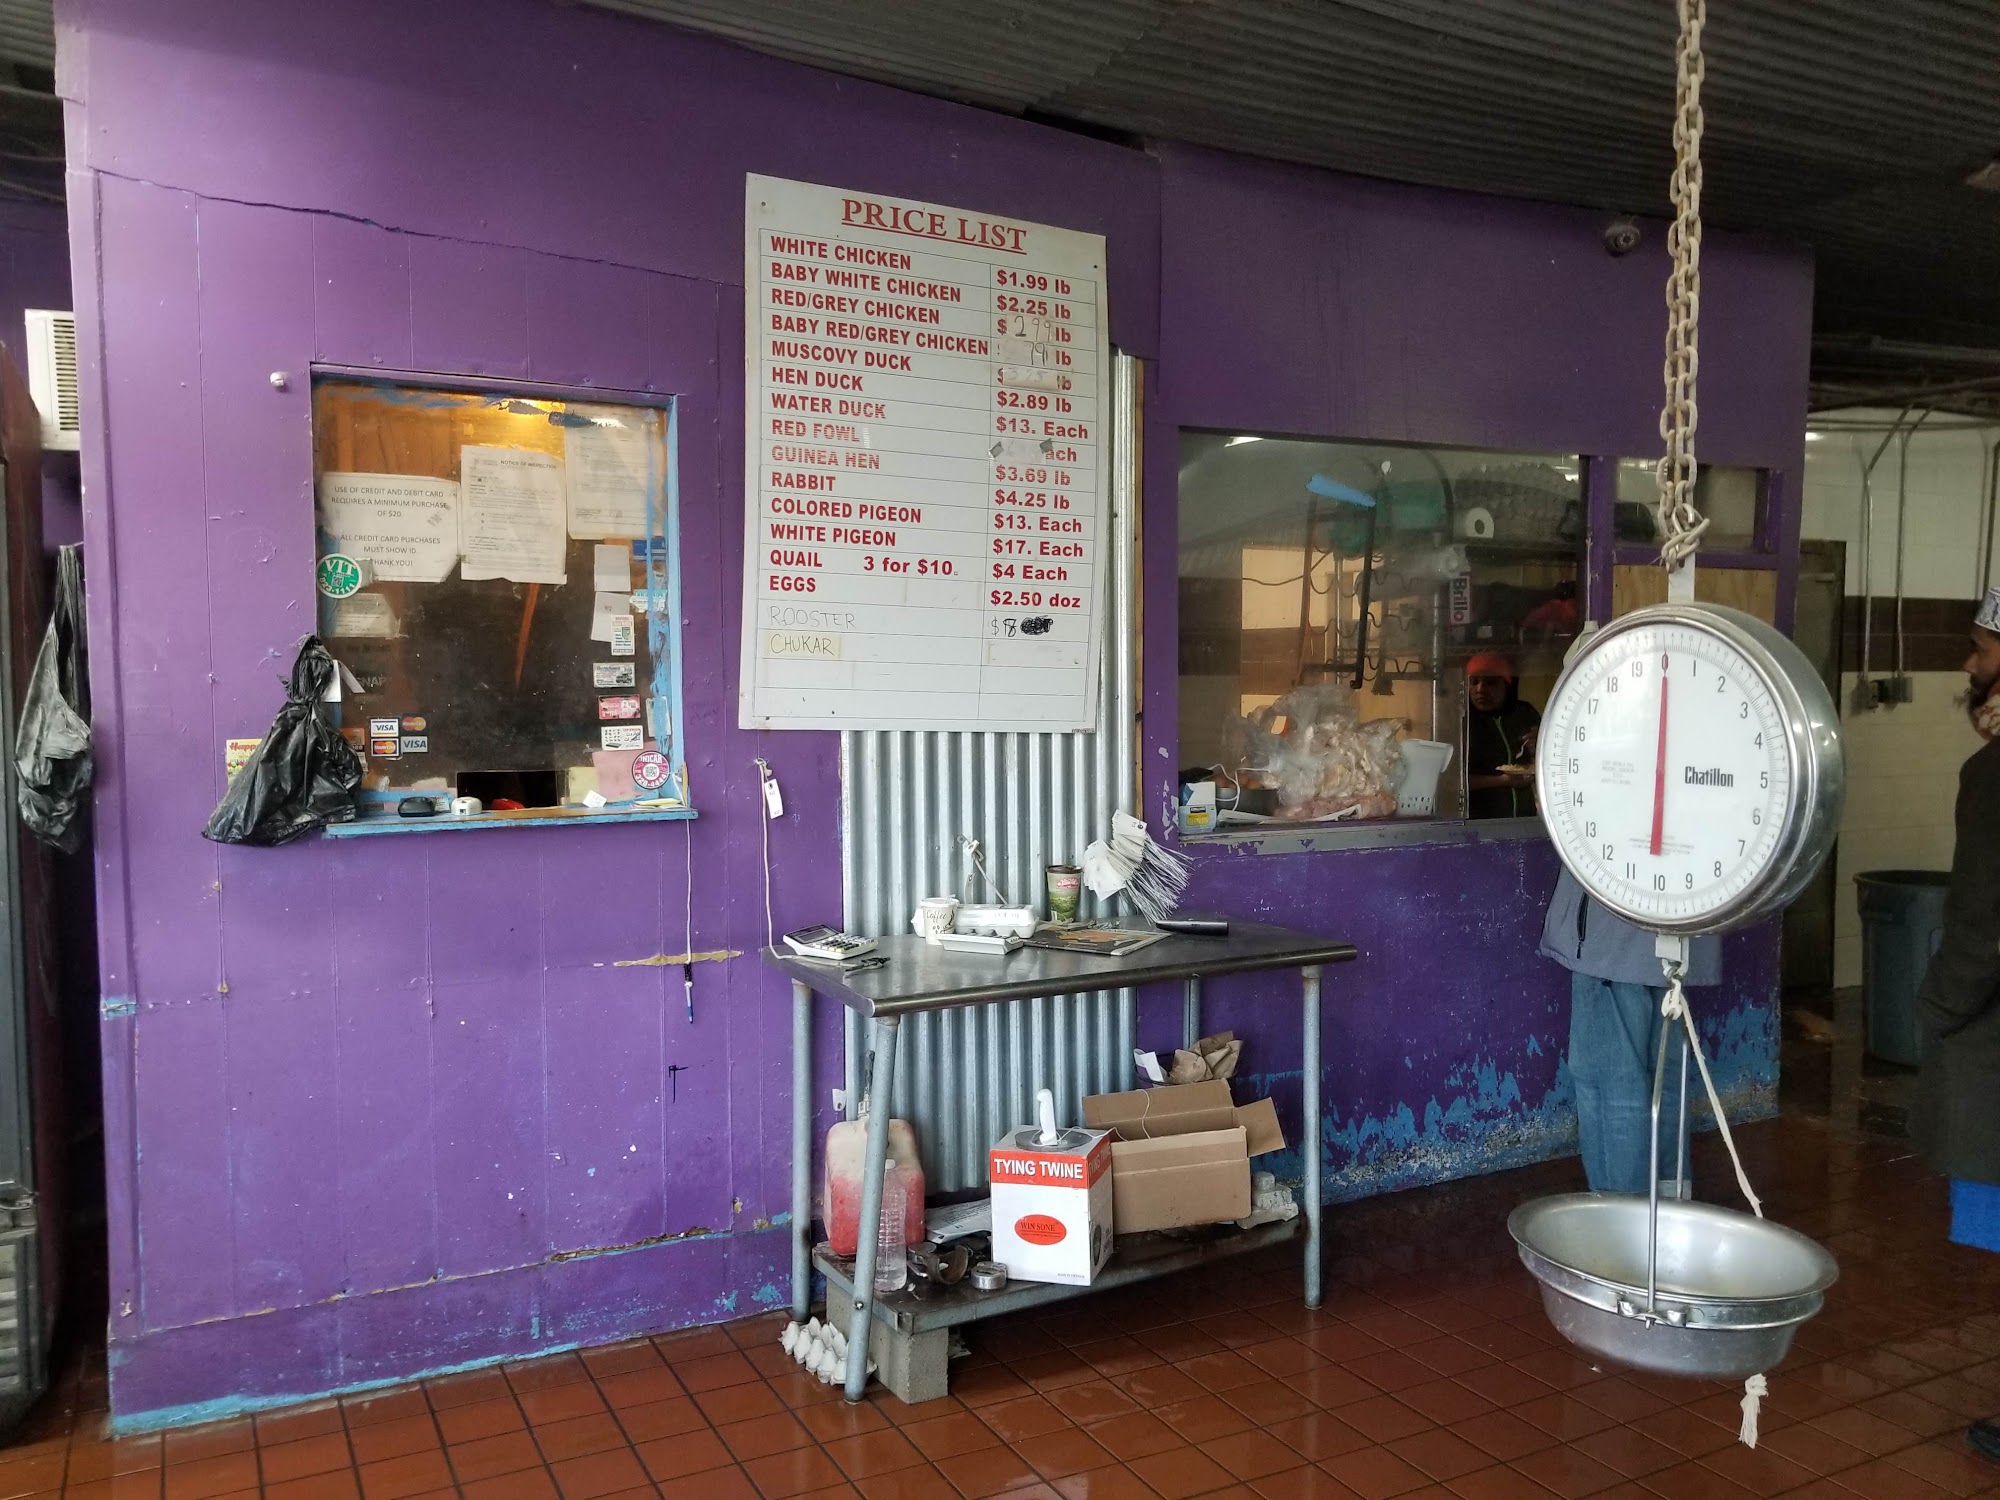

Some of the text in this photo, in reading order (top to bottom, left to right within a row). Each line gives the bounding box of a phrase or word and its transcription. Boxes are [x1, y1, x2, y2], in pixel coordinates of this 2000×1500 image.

[841, 198, 1027, 250] PRICE LIST
[771, 236, 911, 270] WHITE CHICKEN
[771, 262, 961, 303] BABY WHITE CHICKEN
[997, 269, 1071, 295] $1.99 lb
[771, 288, 940, 325] RED/GREY CHICKEN
[996, 294, 1071, 319] $2.25 lb
[771, 314, 989, 355] BABY RED/GREY CHICKEN
[1055, 327, 1071, 343] lb
[771, 340, 912, 371] MUSCOVY DUCK
[1056, 350, 1072, 366] lb
[771, 366, 864, 391] HEN DUCK
[771, 392, 887, 419] WATER DUCK
[997, 390, 1071, 413] $2.89 lb
[771, 419, 860, 443] RED FOWL
[996, 416, 1088, 439] $13. Each
[771, 445, 880, 470] GUINEA HEN
[1045, 447, 1077, 462] ach
[771, 472, 836, 492] RABBIT
[995, 464, 1070, 486] $3.69 lb
[361, 487, 385, 495] CREDIT
[404, 489, 423, 497] DEBIT
[425, 490, 444, 498] CARD
[995, 488, 1070, 510] $4.25 lb
[331, 497, 366, 505] REQUIRES
[374, 499, 410, 507] MINIMUM
[411, 500, 448, 509] PURCHASE
[771, 497, 922, 523] COLORED PIGEON
[994, 513, 1082, 533] $13. Each
[354, 534, 379, 542] CREDIT
[380, 535, 399, 543] CARD
[401, 536, 441, 544] PURCHASES
[771, 524, 896, 546] WHITE PIGEON
[993, 538, 1083, 557] $17. Each
[324, 559, 357, 577] VIT
[373, 559, 394, 567] HANK
[770, 549, 823, 568] QUAIL
[863, 556, 875, 571] 3
[882, 557, 910, 573] for
[992, 563, 1067, 581] $4 Each
[769, 575, 817, 593] EGGS
[990, 589, 1081, 608] $2.50 doz
[1453, 577, 1467, 621] Brillo
[770, 605, 857, 629] ROOSTER
[770, 634, 835, 656] CHUKAR
[1631, 660, 1643, 678] 19
[1692, 660, 1697, 677] 1
[1607, 676, 1618, 693] 18
[1718, 675, 1726, 693] 2
[1588, 698, 1599, 715] 17
[1740, 701, 1748, 719] 3
[1574, 726, 1586, 742] 16
[1754, 732, 1762, 749] 4
[230, 742, 257, 751] Happ
[403, 740, 427, 748] VISA
[1568, 758, 1579, 774] 15
[1684, 765, 1734, 788] Chatillon
[1760, 771, 1768, 789] 5
[1572, 790, 1584, 808] 14
[1752, 808, 1761, 825] 6
[1585, 821, 1597, 838] 13
[1602, 844, 1614, 861] 12
[1738, 839, 1746, 856] 7
[1626, 862, 1636, 880] 11
[1714, 861, 1722, 878] 8
[1654, 874, 1666, 891] 10
[1685, 872, 1693, 890] 9
[926, 909, 947, 920] Coffee
[994, 1158, 1084, 1179] TYING TWINE
[1020, 1222, 1056, 1232] WIN SONE
